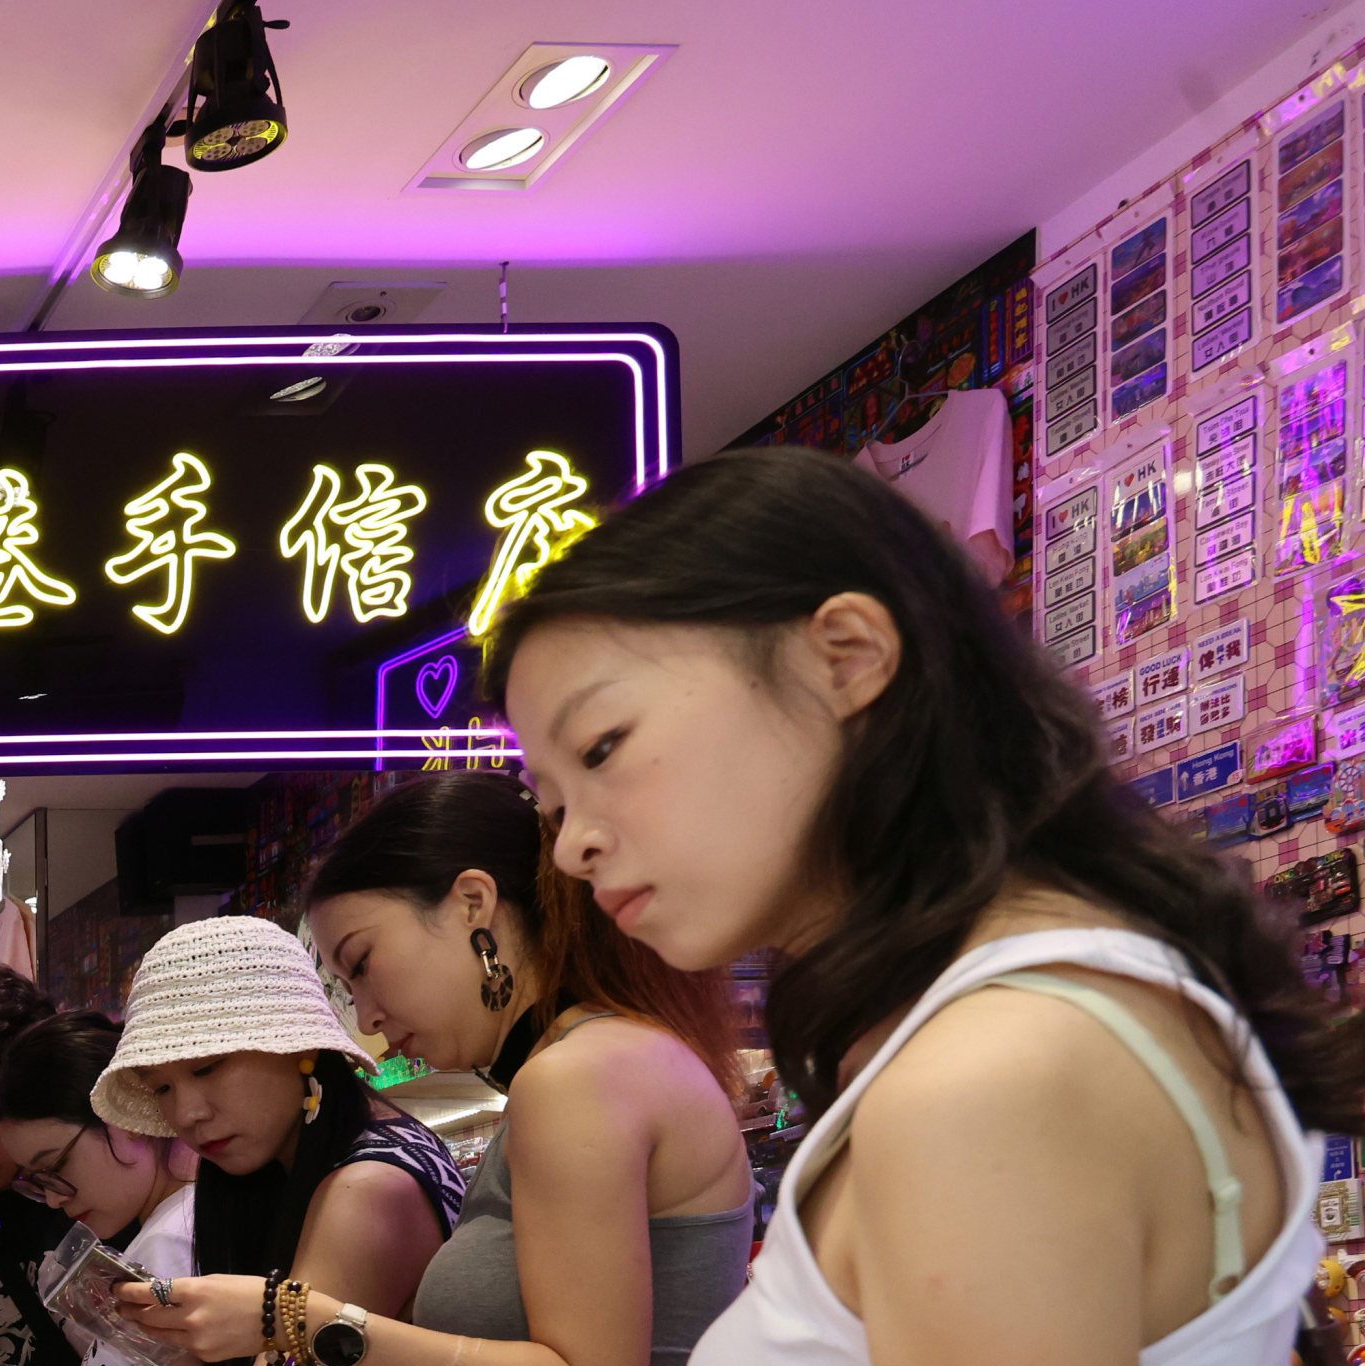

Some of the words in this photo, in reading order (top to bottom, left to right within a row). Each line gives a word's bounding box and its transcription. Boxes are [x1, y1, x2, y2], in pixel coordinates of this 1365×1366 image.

[1071, 276, 1090, 300] HK
[1137, 459, 1157, 482] HK
[1070, 498, 1090, 518] HK
[1139, 661, 1161, 677] GOOD
[1162, 653, 1182, 668] LUCK
[1192, 757, 1214, 770] Hong
[1214, 748, 1235, 763] Kong
[1192, 767, 1218, 786] 香港
